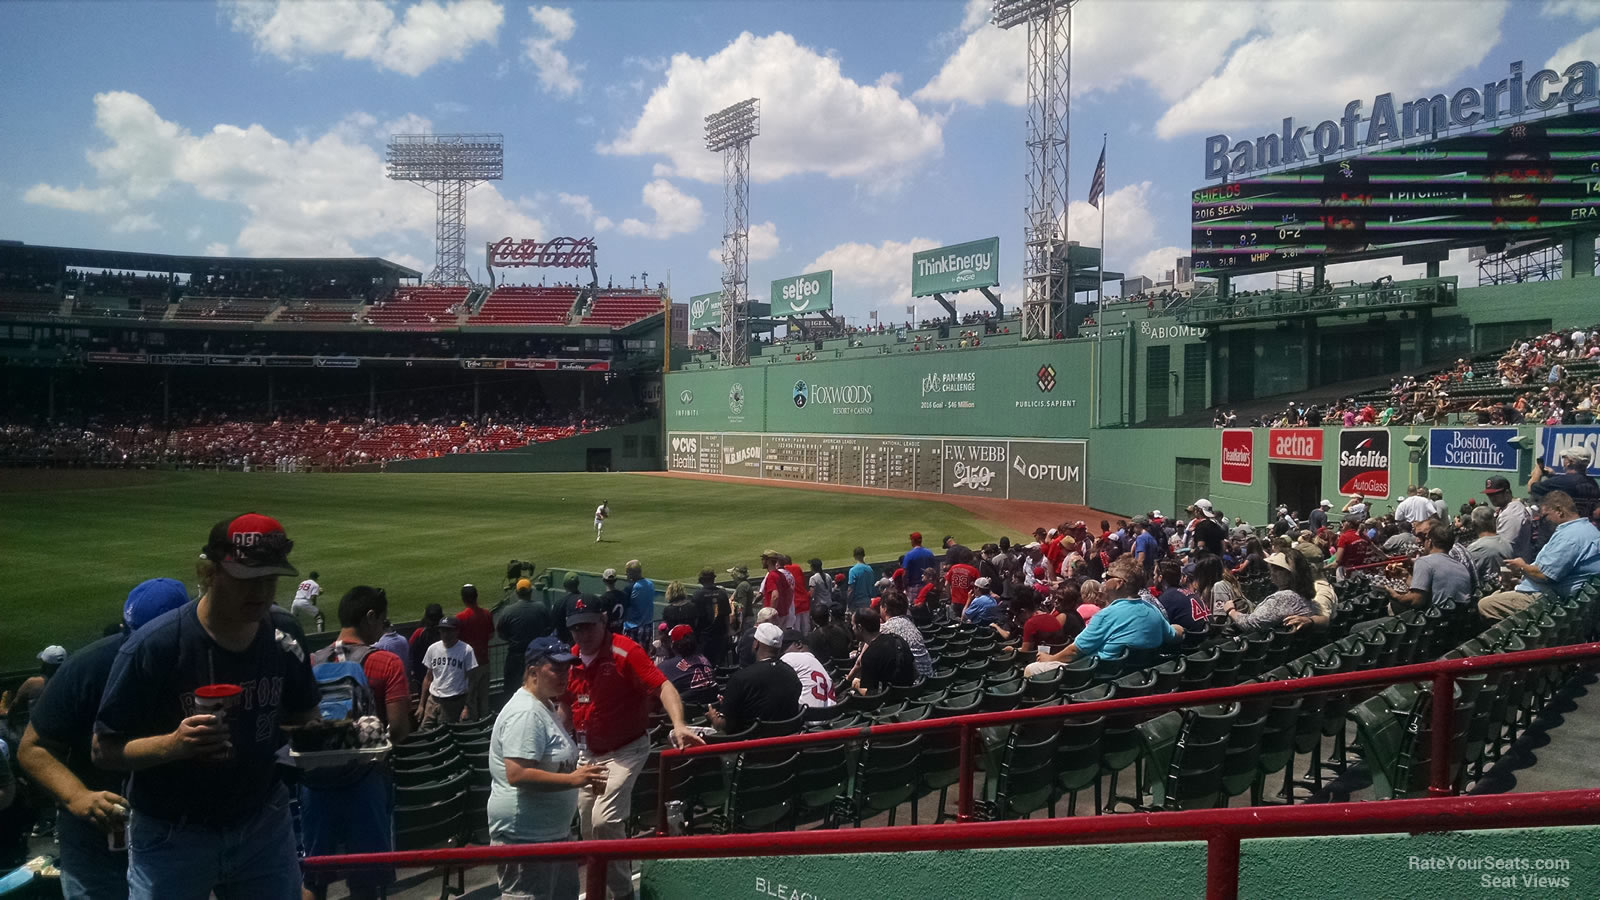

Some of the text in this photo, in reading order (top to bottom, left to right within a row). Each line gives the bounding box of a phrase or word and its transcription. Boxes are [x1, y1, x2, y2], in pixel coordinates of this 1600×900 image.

[1205, 60, 1600, 179] Bank of America
[1194, 184, 1241, 205] SHIELDS
[1196, 203, 1254, 220] 2016 SEASON
[1570, 206, 1598, 220] ERA
[1239, 233, 1257, 246] 8.2
[1279, 228, 1302, 240] 0-2
[917, 252, 991, 277] ThinkEnergy
[1194, 260, 1212, 270] ERA
[1250, 252, 1271, 264] WHIP
[1150, 324, 1207, 340] ABIOMED
[942, 372, 976, 383] PAN-MASS
[942, 382, 976, 392] CHALLENGE
[679, 437, 697, 453] CVS
[1276, 433, 1314, 457] aetna
[1453, 431, 1490, 449] Boston
[944, 445, 966, 461] F.W.
[968, 445, 1006, 462] WEBB
[1445, 442, 1505, 467] Scientific
[1552, 432, 1600, 469] NS
[672, 453, 697, 469] Health
[1340, 450, 1389, 469] Safelite
[1028, 464, 1080, 483] OPTUM
[1352, 478, 1388, 493] AutoGlass
[431, 656, 464, 670] BOSTON
[179, 676, 286, 717] BTON
[755, 876, 827, 900] BLEAC
